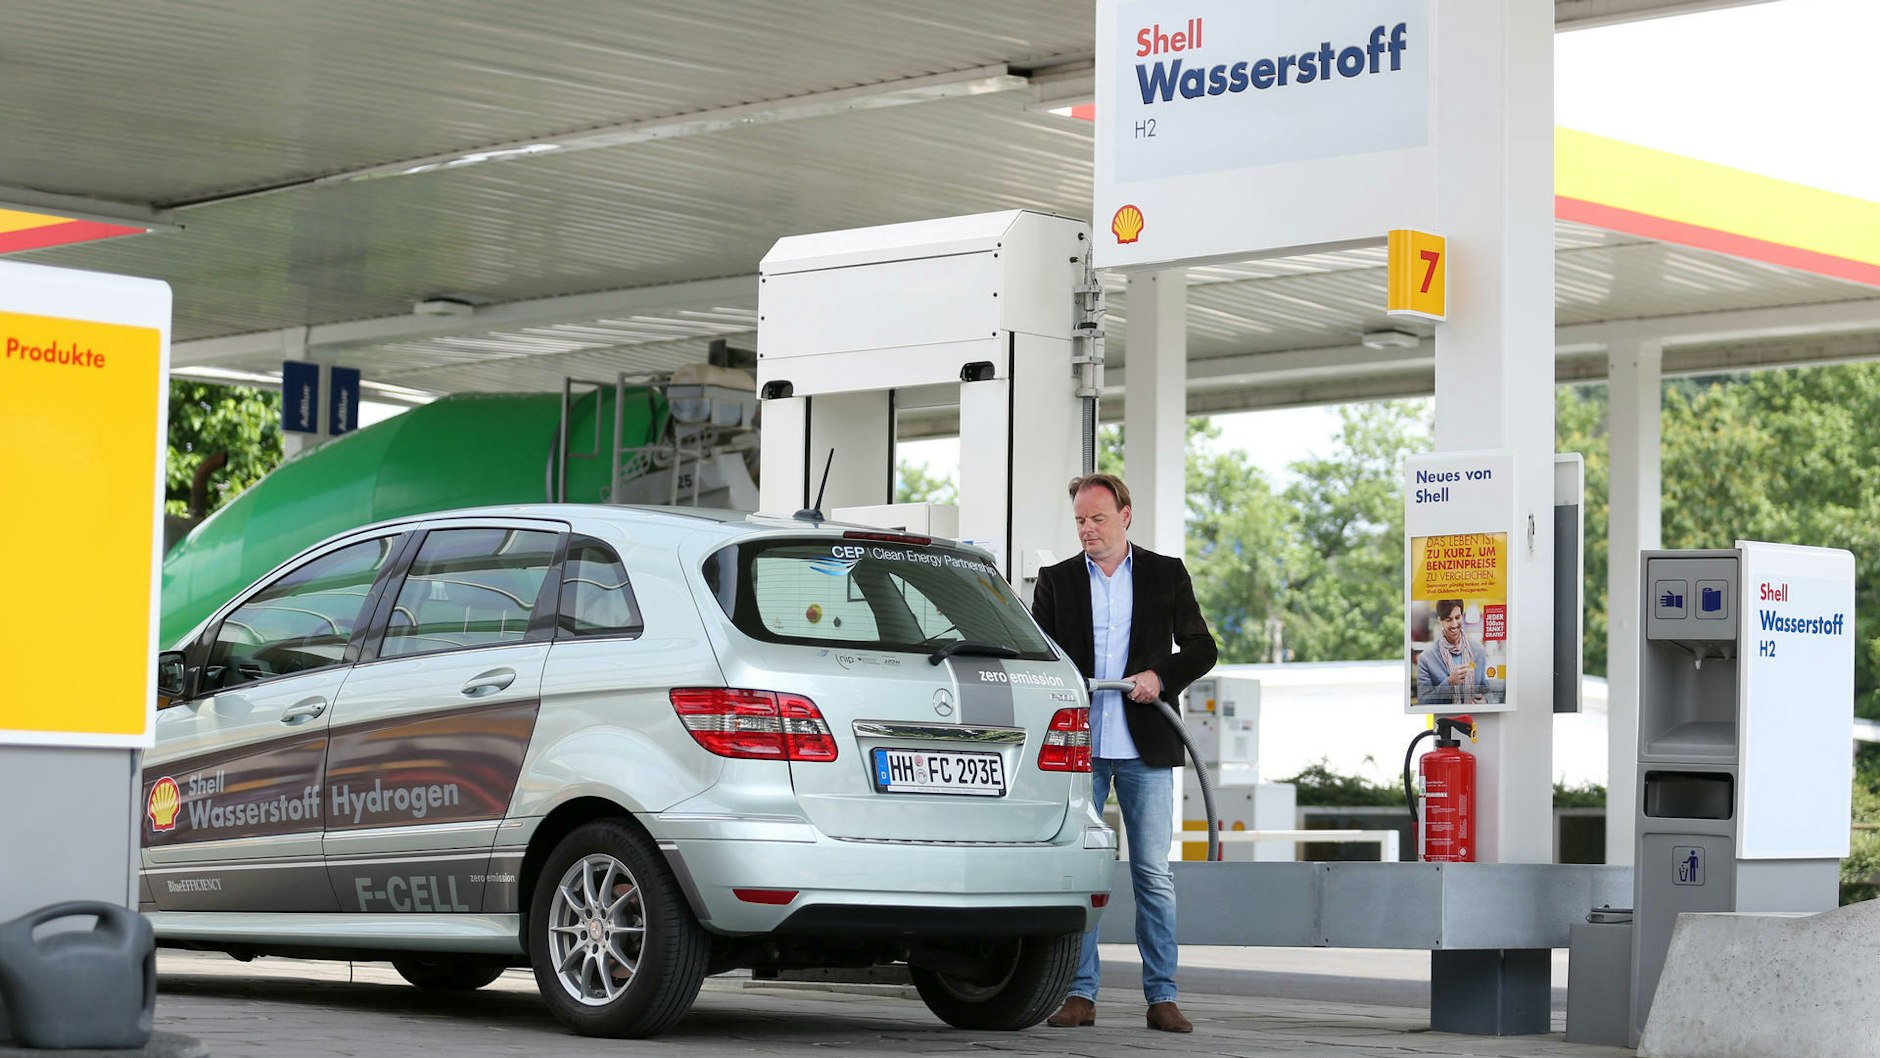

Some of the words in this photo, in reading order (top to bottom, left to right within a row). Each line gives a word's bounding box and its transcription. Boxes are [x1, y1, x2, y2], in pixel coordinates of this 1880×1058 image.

[1136, 17, 1203, 57] Shell
[1135, 22, 1407, 105] Wasserstoff
[1135, 118, 1157, 139] H2
[1420, 249, 1440, 294] 7
[6, 337, 105, 368] Produkte
[1416, 470, 1460, 484] Neues
[1465, 469, 1492, 481] von
[1416, 487, 1449, 503] Shell
[1426, 536, 1445, 547] DAS
[1449, 535, 1478, 546] LEBEN
[1482, 534, 1495, 545] IST
[832, 546, 865, 559] CEP
[872, 547, 907, 561] Clean
[906, 550, 942, 567] Energy
[944, 555, 997, 577] Partnership
[1427, 549, 1440, 559] ZU
[1444, 547, 1475, 558] KURZ,
[1479, 547, 1496, 557] UM
[1426, 558, 1496, 571] BENZINPREISE
[1426, 572, 1437, 581] ZU
[1439, 570, 1495, 581] VERGLEICHEN.
[1760, 582, 1788, 602] Shell
[1759, 609, 1844, 635] Wasserstoff
[1759, 639, 1776, 657] H2
[978, 670, 1007, 683] zero
[1009, 670, 1064, 687] emission
[881, 771, 887, 780] D
[889, 755, 915, 782] HH
[928, 757, 952, 783] FC
[956, 758, 1001, 786] 293E
[188, 769, 225, 797] Shell
[188, 784, 321, 830] Wasserstoff
[332, 778, 459, 824] Hydrogen
[167, 879, 222, 893] BlueEFFICIENCY
[470, 874, 485, 883] zero
[486, 872, 516, 883] emission
[354, 875, 470, 912] F-CELL
